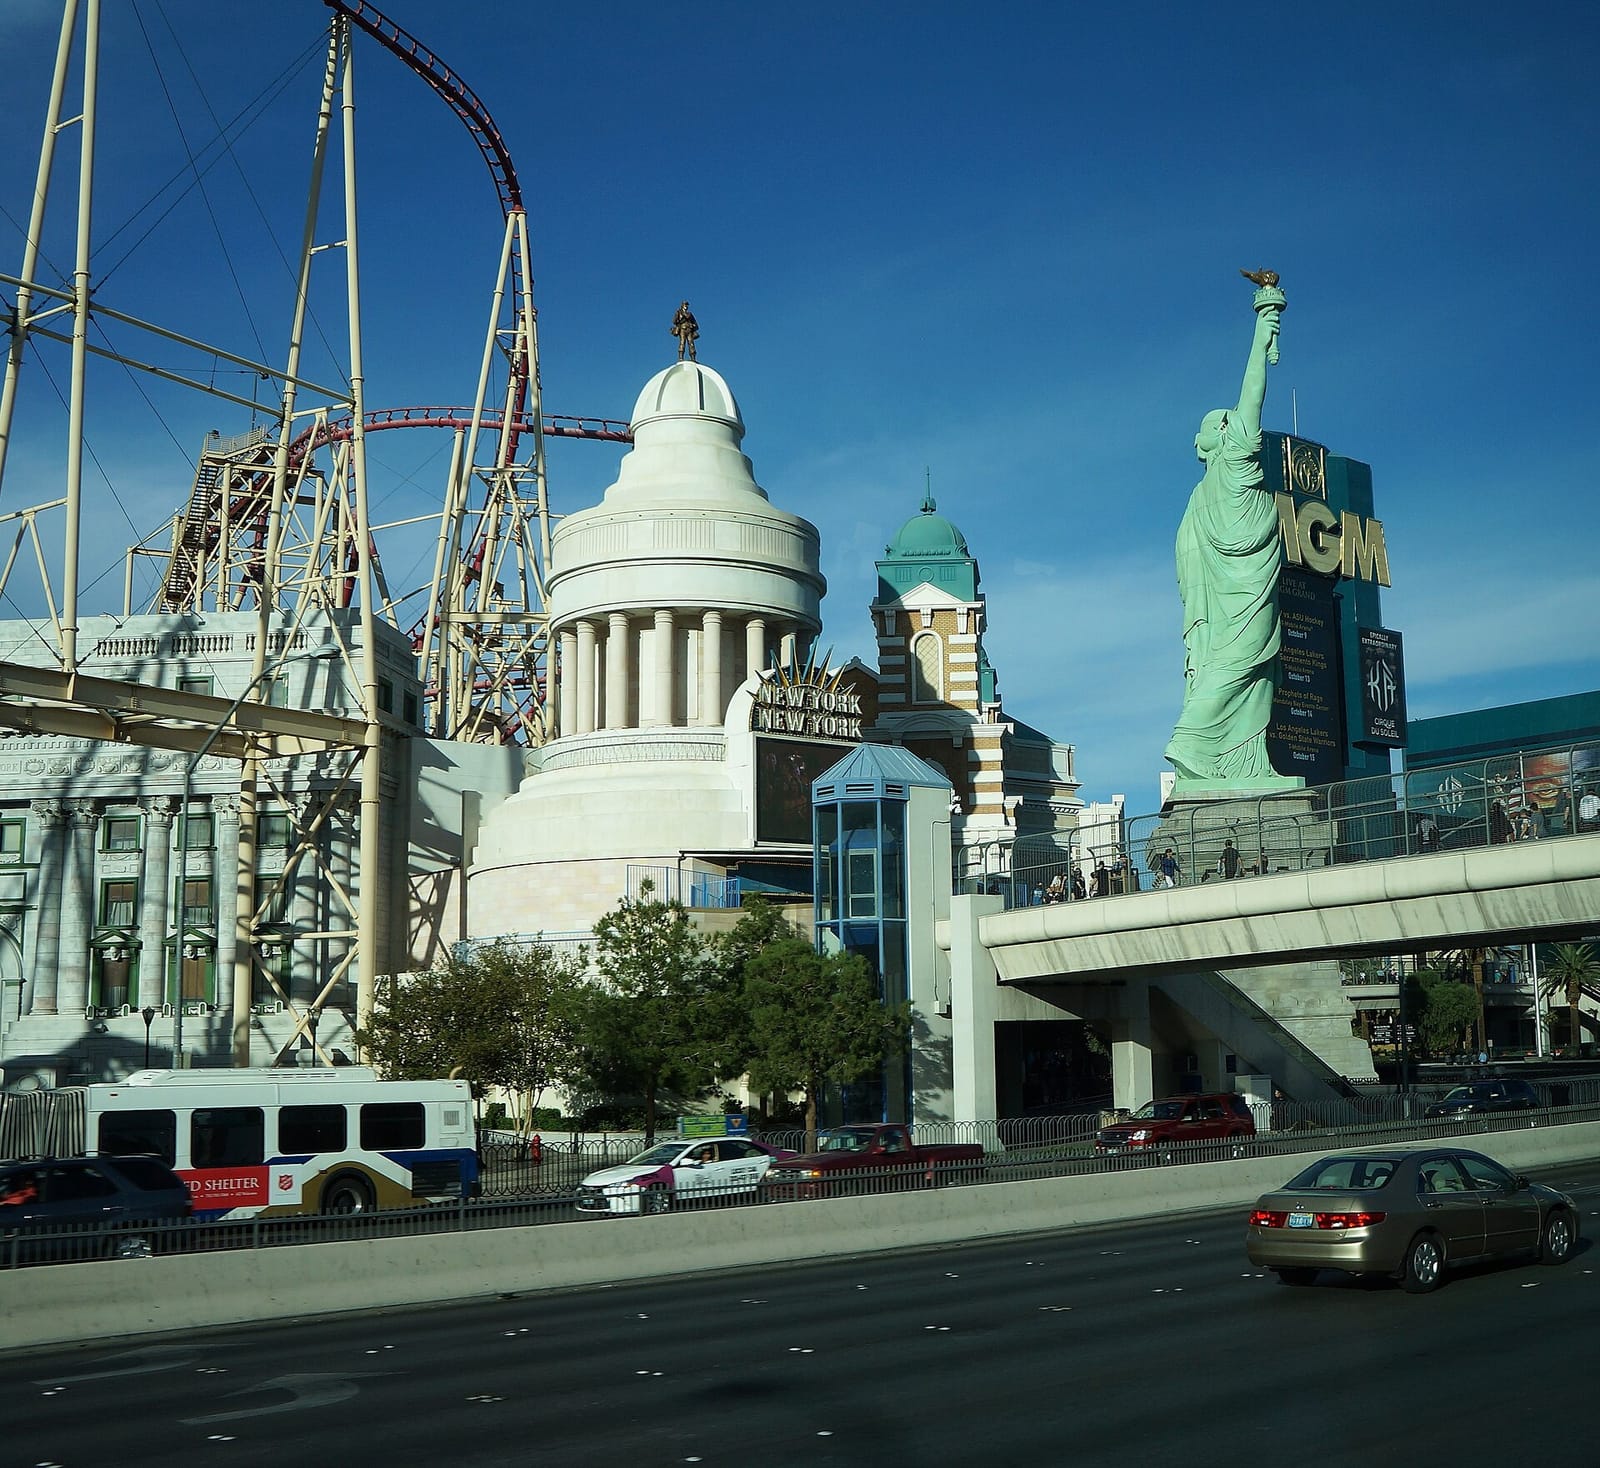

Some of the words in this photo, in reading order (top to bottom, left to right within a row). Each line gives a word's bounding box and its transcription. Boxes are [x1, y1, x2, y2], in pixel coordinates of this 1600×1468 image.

[1287, 628, 1303, 638] October
[1283, 645, 1305, 656] Angeles
[1306, 649, 1325, 660] Lakers
[1287, 672, 1304, 681] October
[760, 683, 805, 708] NEW
[812, 689, 862, 715] YORK
[1278, 687, 1303, 699] Prophets
[1290, 707, 1307, 717] October
[759, 707, 805, 732] NEW
[812, 713, 862, 738] YORK
[1374, 717, 1395, 729] CIRQUE
[1276, 722, 1287, 731] Los
[1287, 724, 1309, 735] Angeles
[1310, 728, 1329, 738] Lakers
[1371, 726, 1380, 735] DU
[1380, 728, 1400, 739] SOLEIL
[1278, 731, 1298, 742] Golden
[1298, 735, 1313, 744] State
[1313, 736, 1336, 747] Warriors
[1292, 751, 1309, 760] October
[204, 1177, 260, 1191] SHELTER
